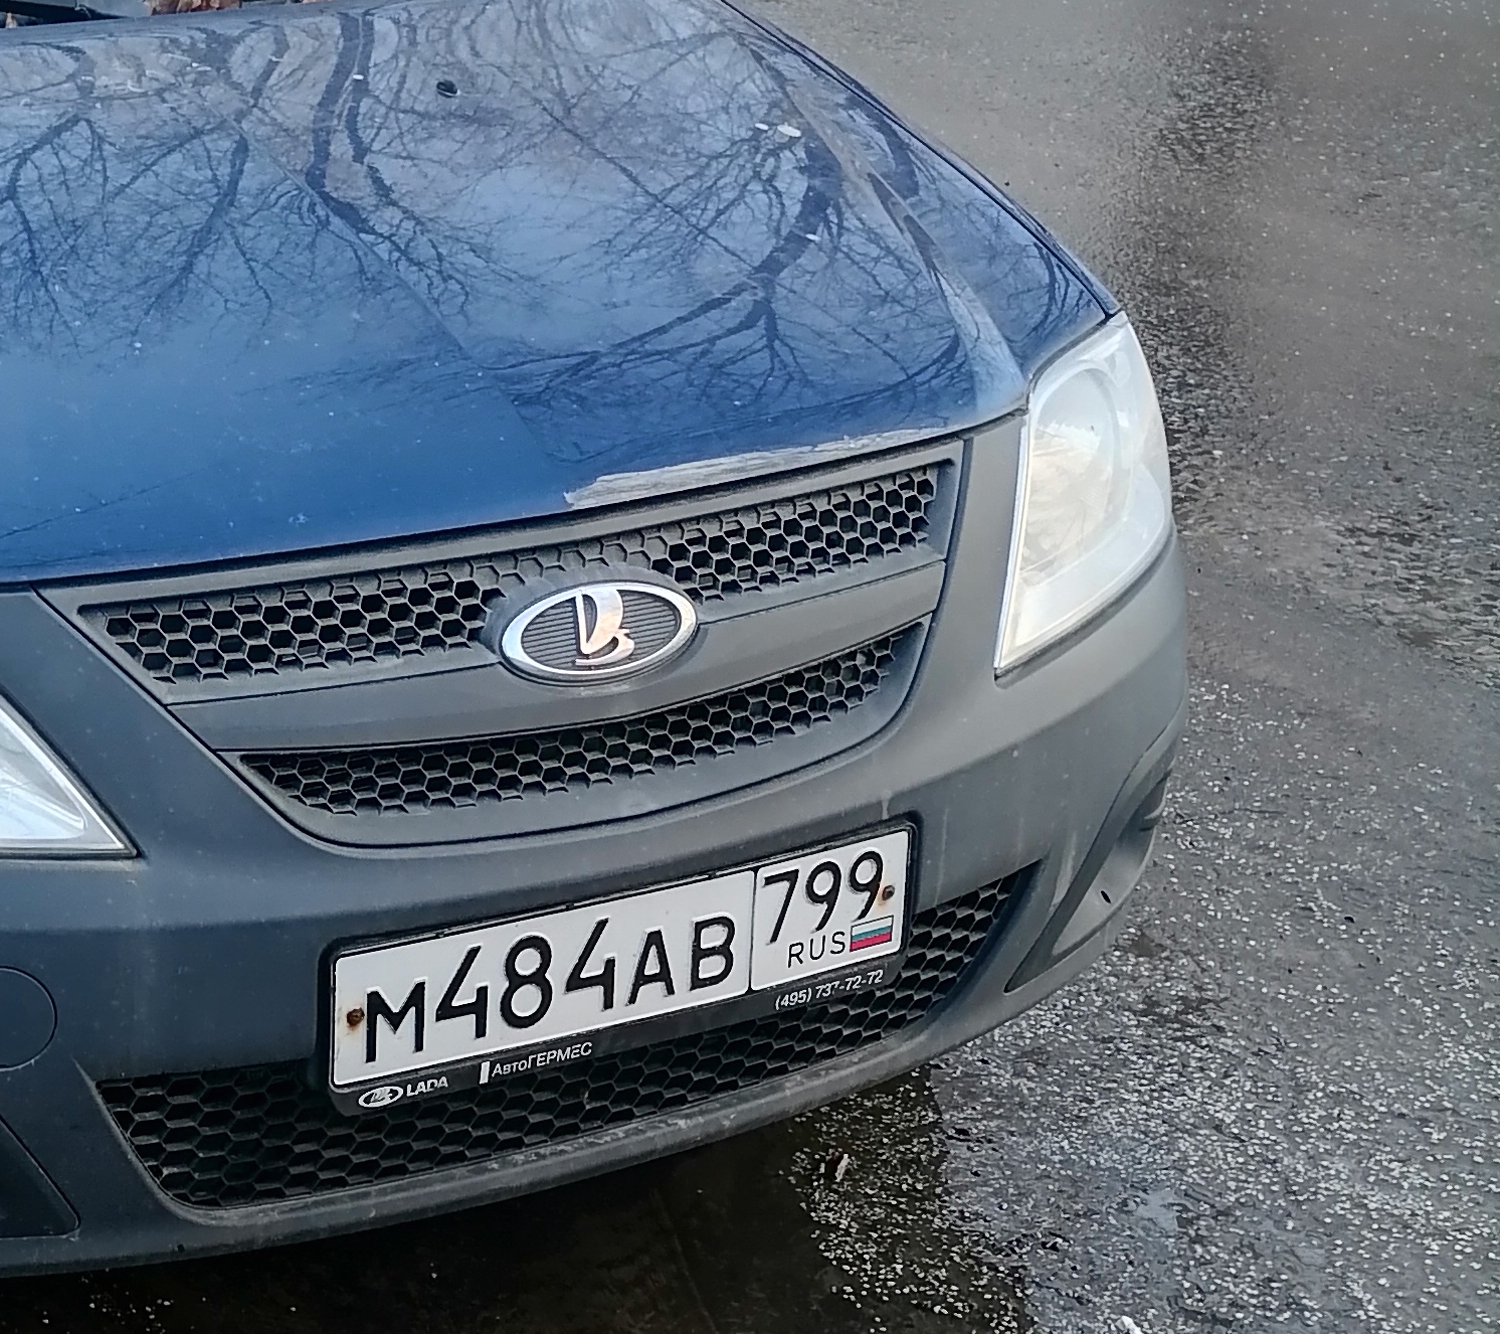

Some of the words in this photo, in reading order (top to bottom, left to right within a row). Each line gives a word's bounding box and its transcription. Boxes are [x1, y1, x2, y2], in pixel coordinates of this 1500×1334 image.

[762, 850, 884, 945] 799
[787, 931, 846, 968] RUS
[774, 988, 813, 1010] (495)
[405, 1075, 449, 1098] LADA
